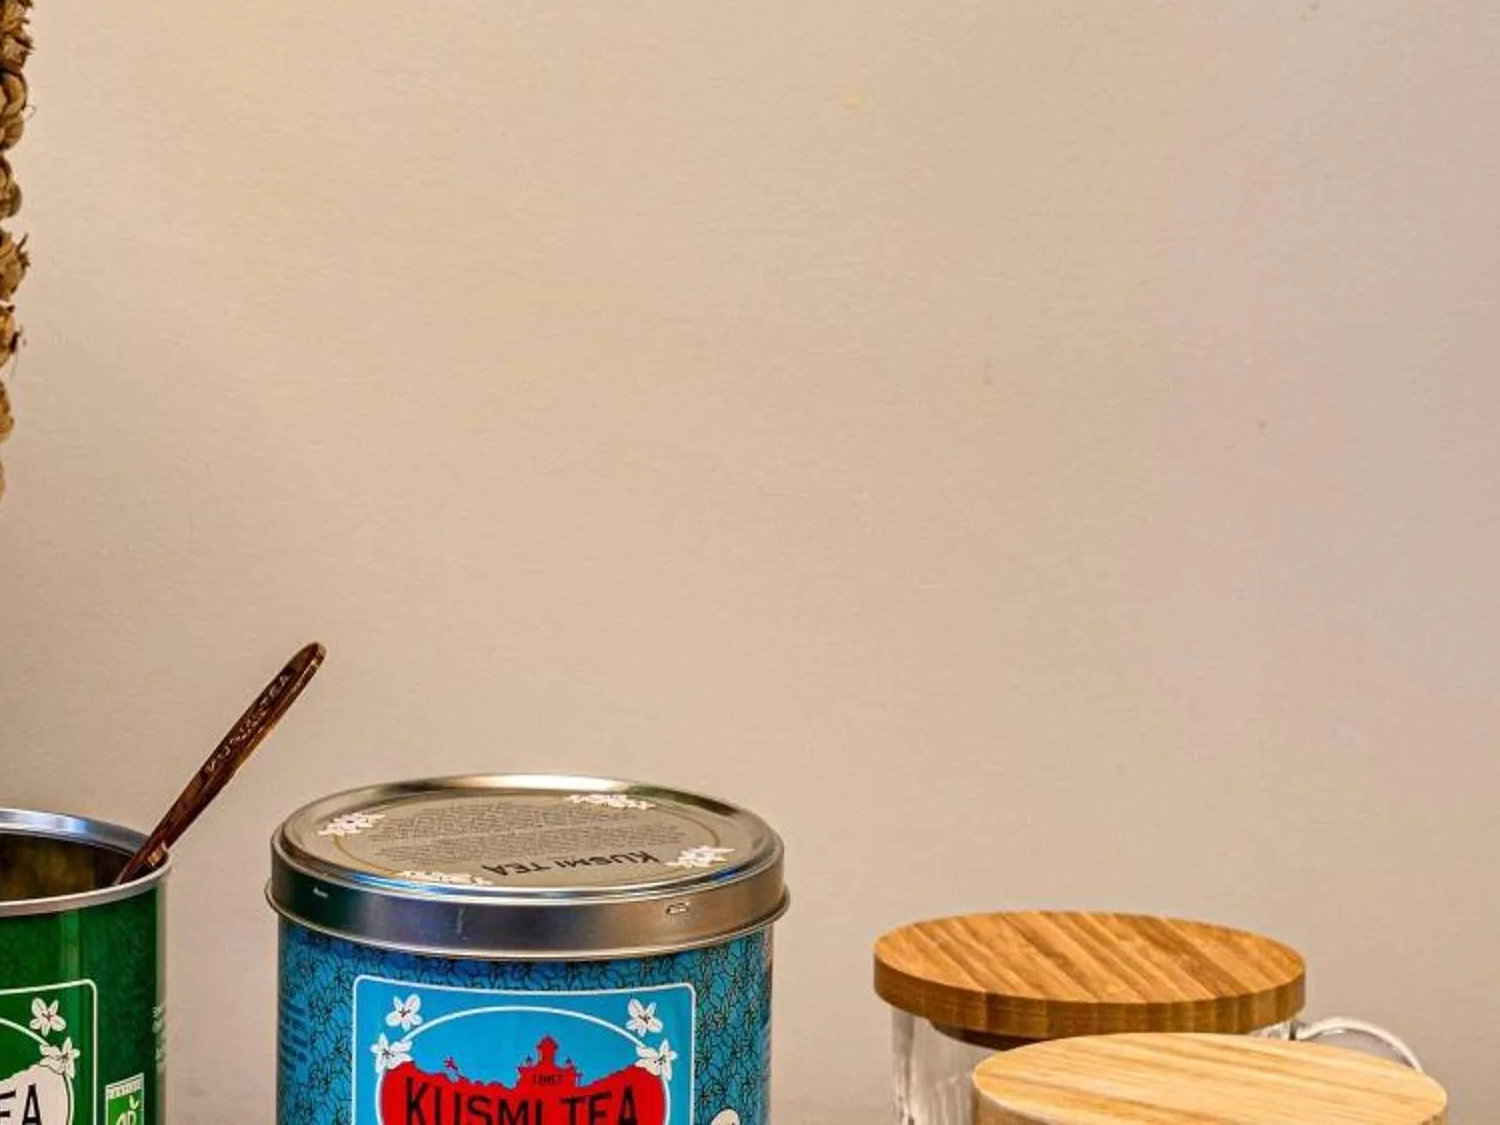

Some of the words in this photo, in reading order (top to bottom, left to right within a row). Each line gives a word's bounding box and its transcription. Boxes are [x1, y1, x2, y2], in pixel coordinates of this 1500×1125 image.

[554, 850, 660, 868] KUSMI
[481, 862, 551, 876] TEA
[560, 1084, 639, 1125] TEA
